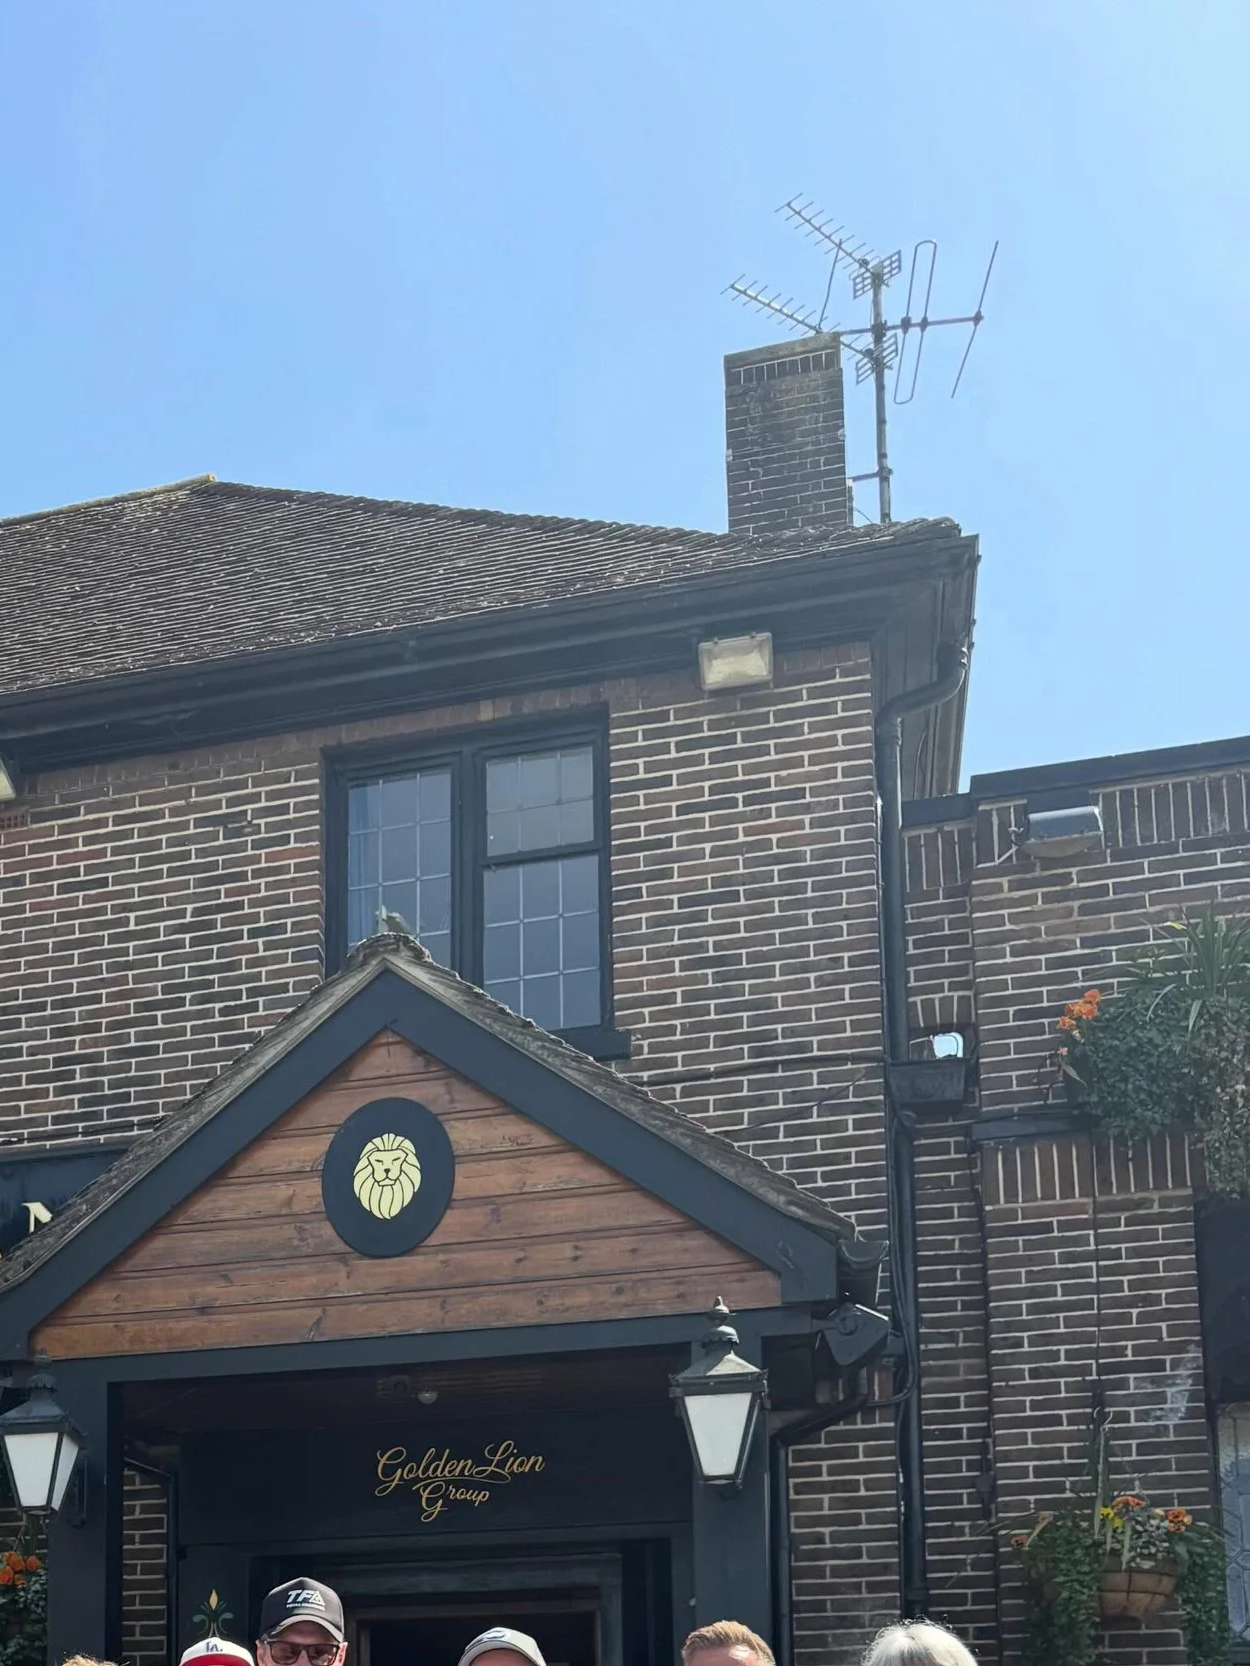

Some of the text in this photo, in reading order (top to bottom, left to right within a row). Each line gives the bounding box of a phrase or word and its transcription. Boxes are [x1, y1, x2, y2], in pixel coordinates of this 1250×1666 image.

[374, 1440, 546, 1497] Golden Lion
[419, 1481, 490, 1522] Group
